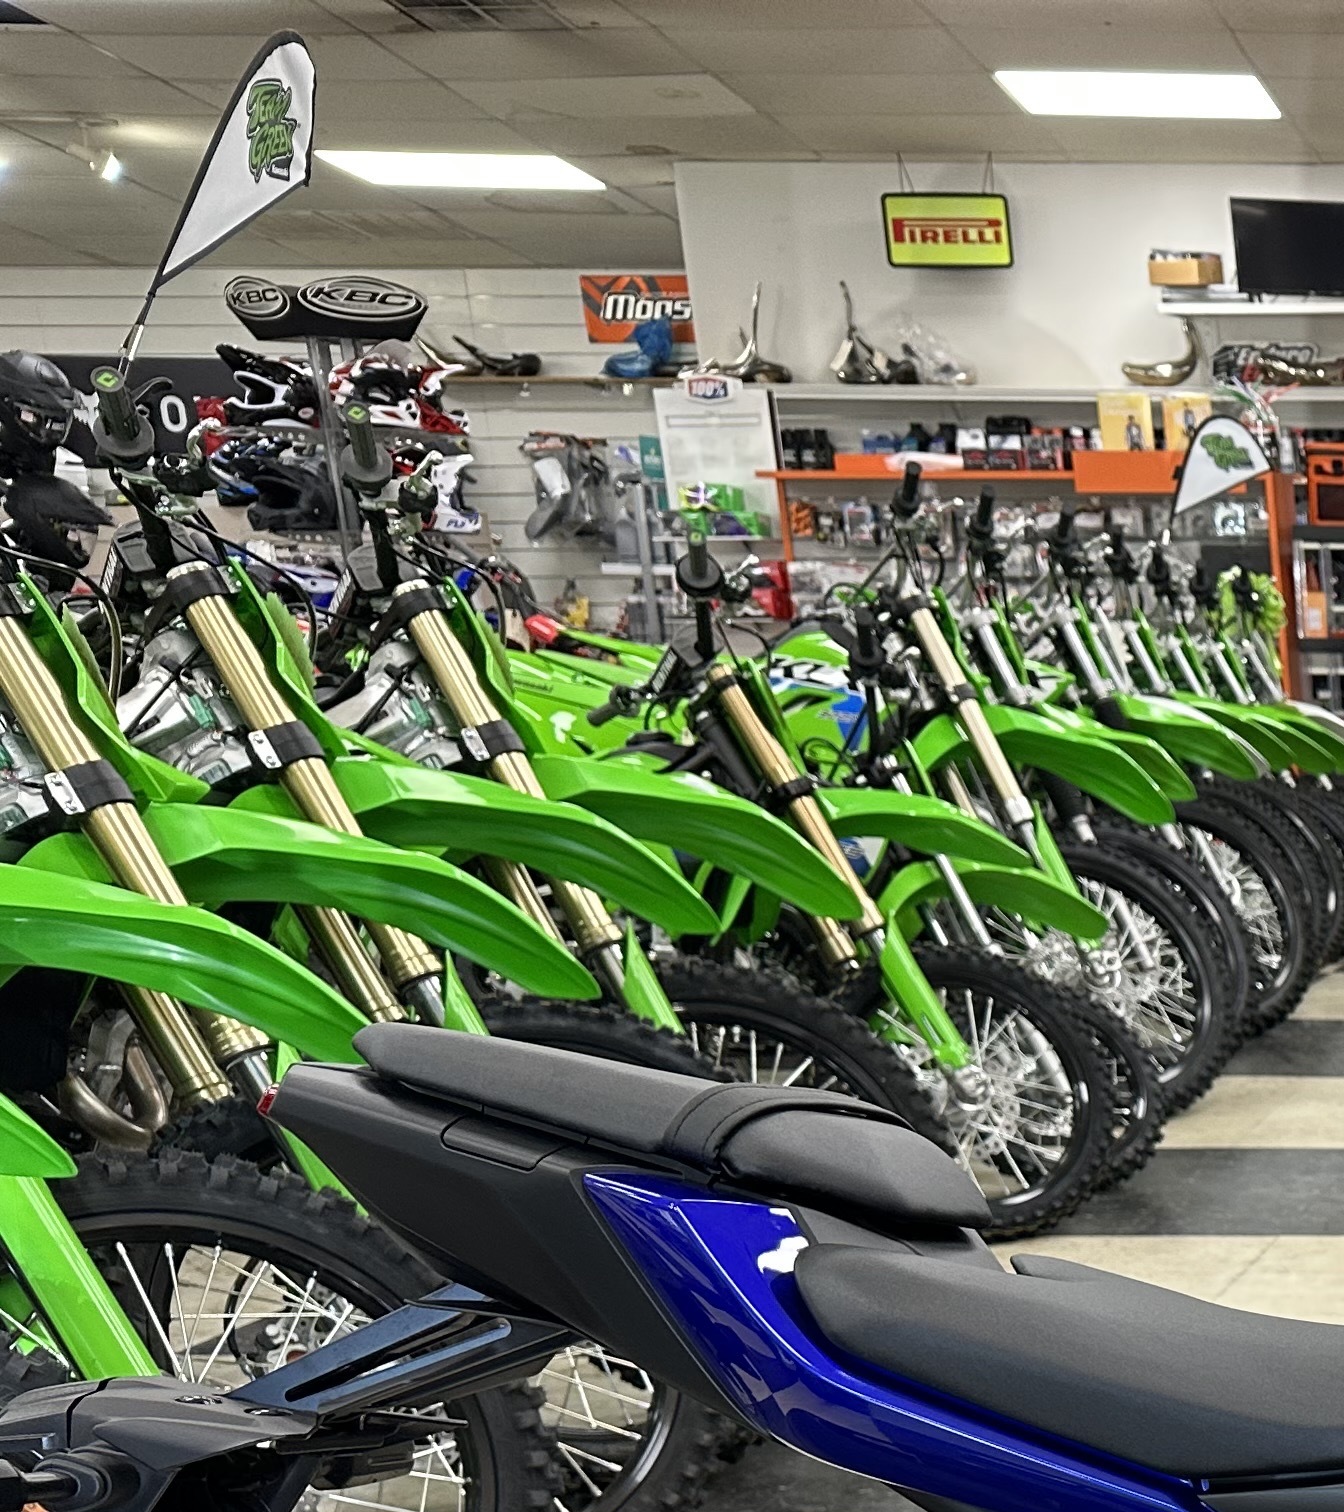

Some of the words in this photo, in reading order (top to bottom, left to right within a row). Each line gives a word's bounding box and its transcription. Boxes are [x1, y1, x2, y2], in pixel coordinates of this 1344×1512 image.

[892, 217, 1002, 244] PIRELLI
[230, 288, 279, 305] KBC
[311, 284, 414, 306] KBC
[690, 379, 727, 398] 100%
